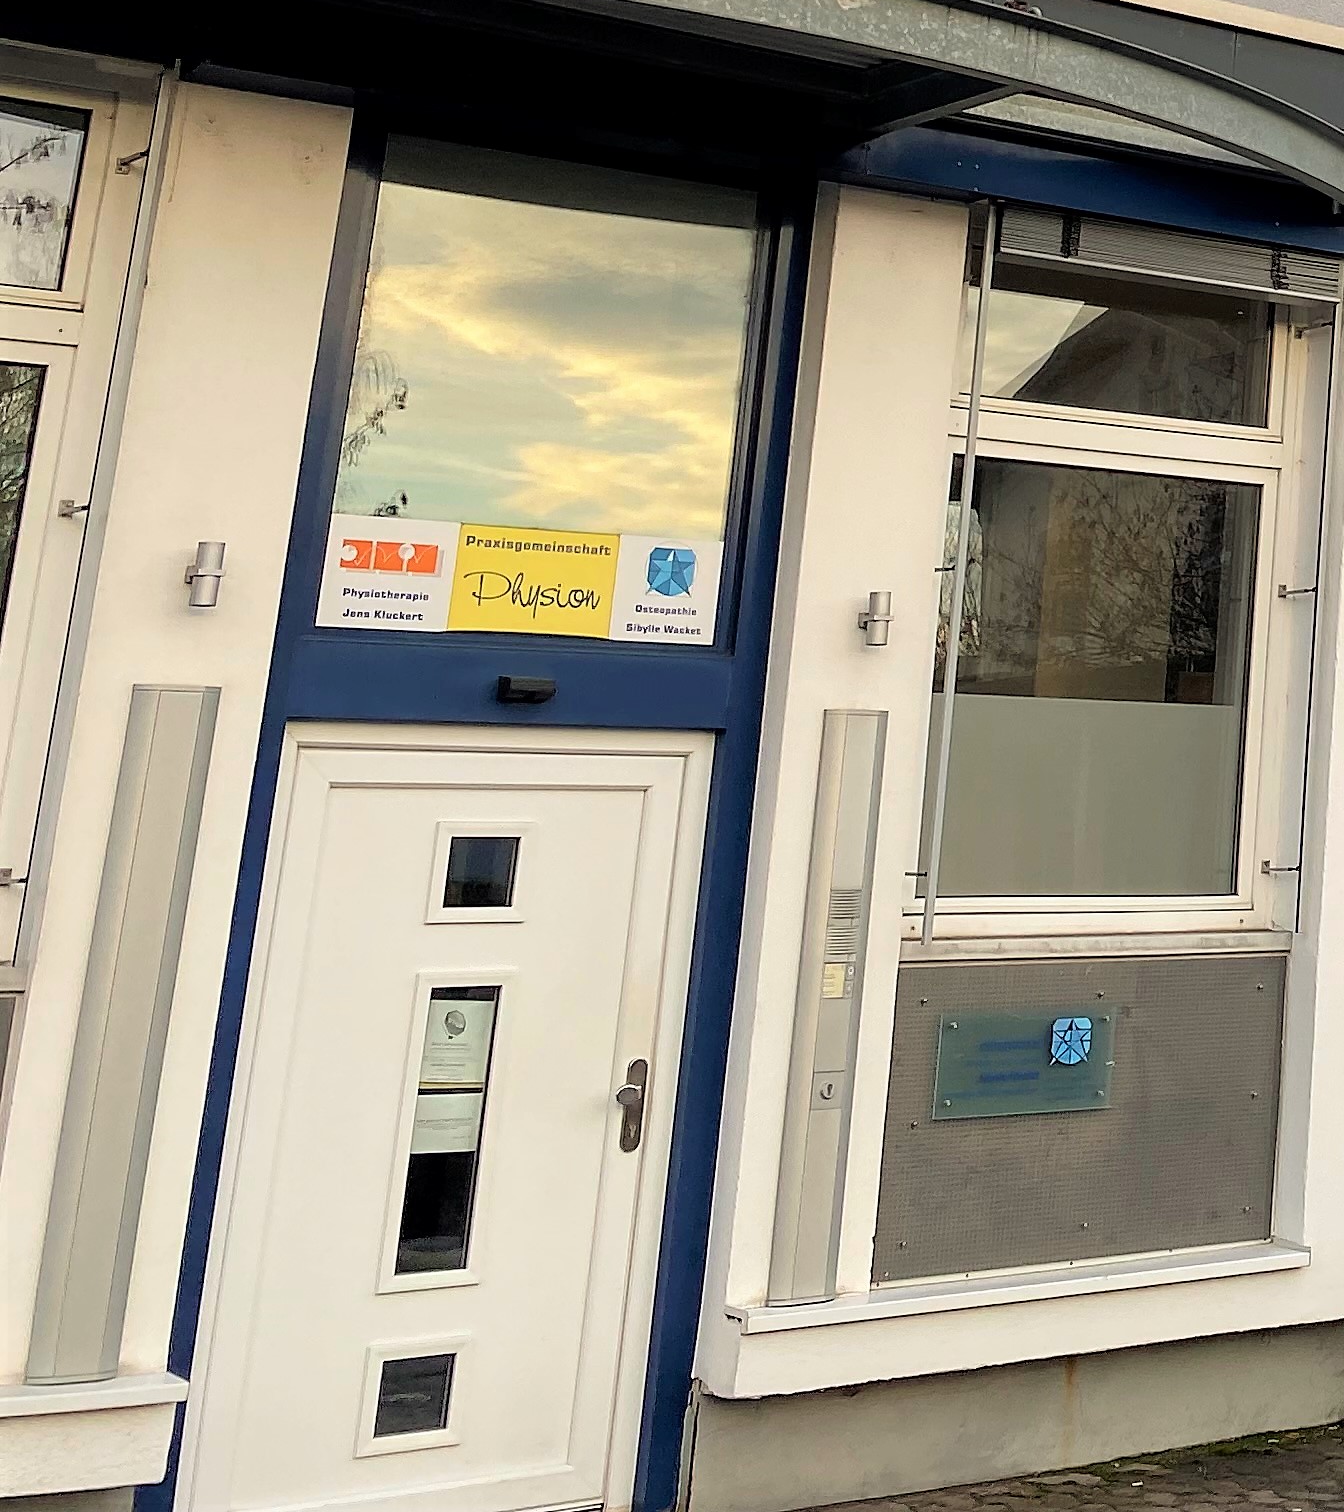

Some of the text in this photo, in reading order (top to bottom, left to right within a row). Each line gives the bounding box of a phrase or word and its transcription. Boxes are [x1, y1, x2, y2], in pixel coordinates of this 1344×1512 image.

[465, 535, 612, 556] Praxisgemeinschaft
[342, 587, 430, 602] Physiotherapie
[463, 571, 601, 619] Physion
[342, 608, 424, 621] Jens Kluckert
[635, 604, 697, 616] Osteopathie
[626, 623, 661, 635] Sibylle
